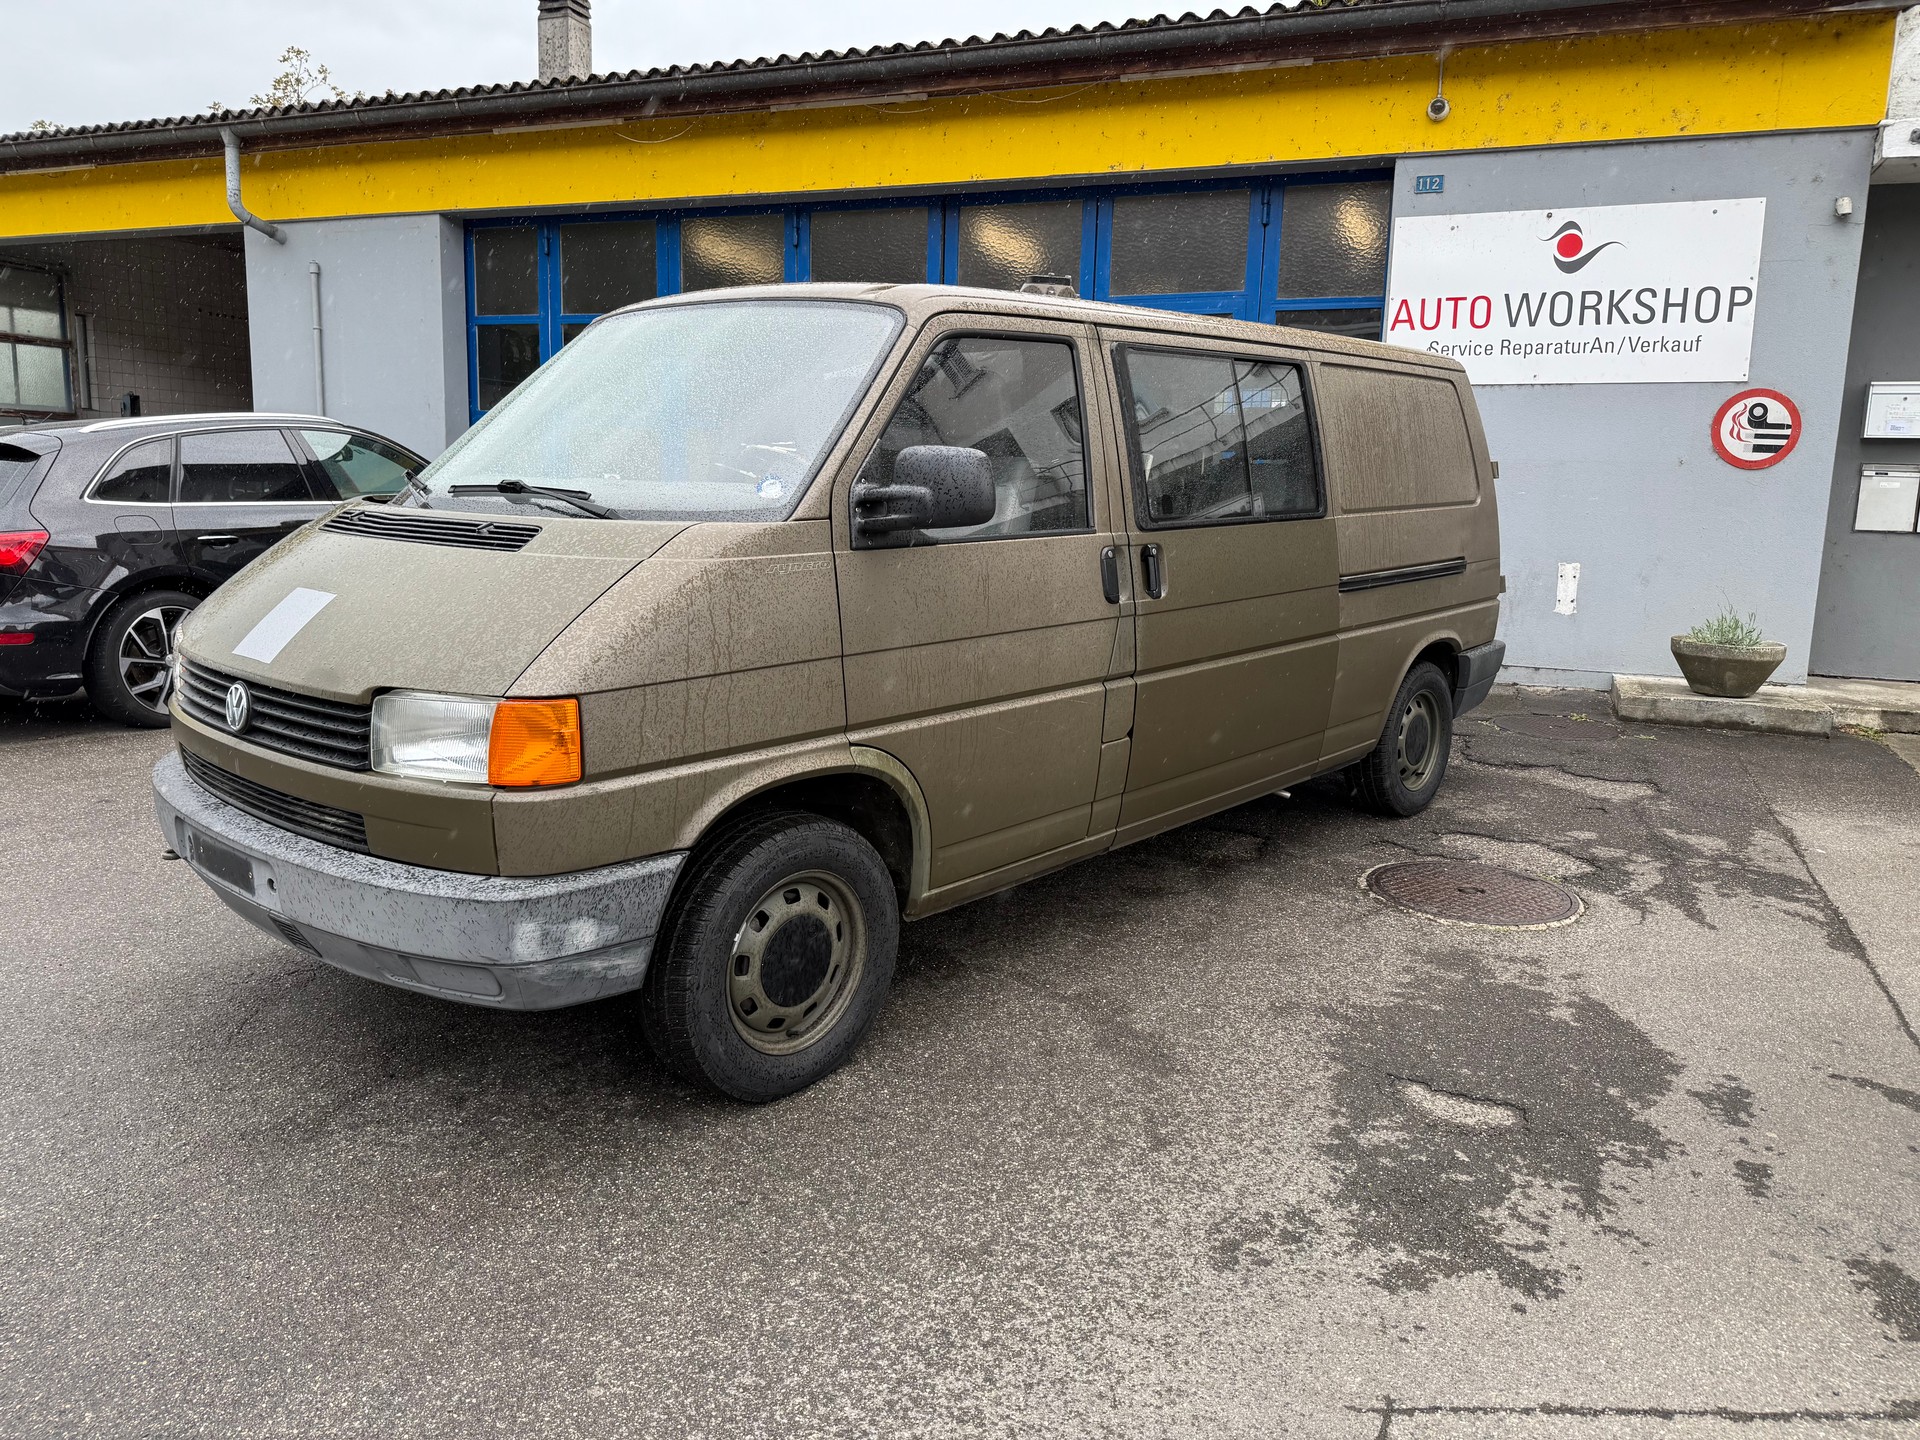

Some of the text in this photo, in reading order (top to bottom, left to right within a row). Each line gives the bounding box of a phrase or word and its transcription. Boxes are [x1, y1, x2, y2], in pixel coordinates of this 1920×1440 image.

[1418, 177, 1440, 191] 112
[1391, 286, 1752, 331] AUTO WORKSHOP
[1427, 340, 1494, 356] Service
